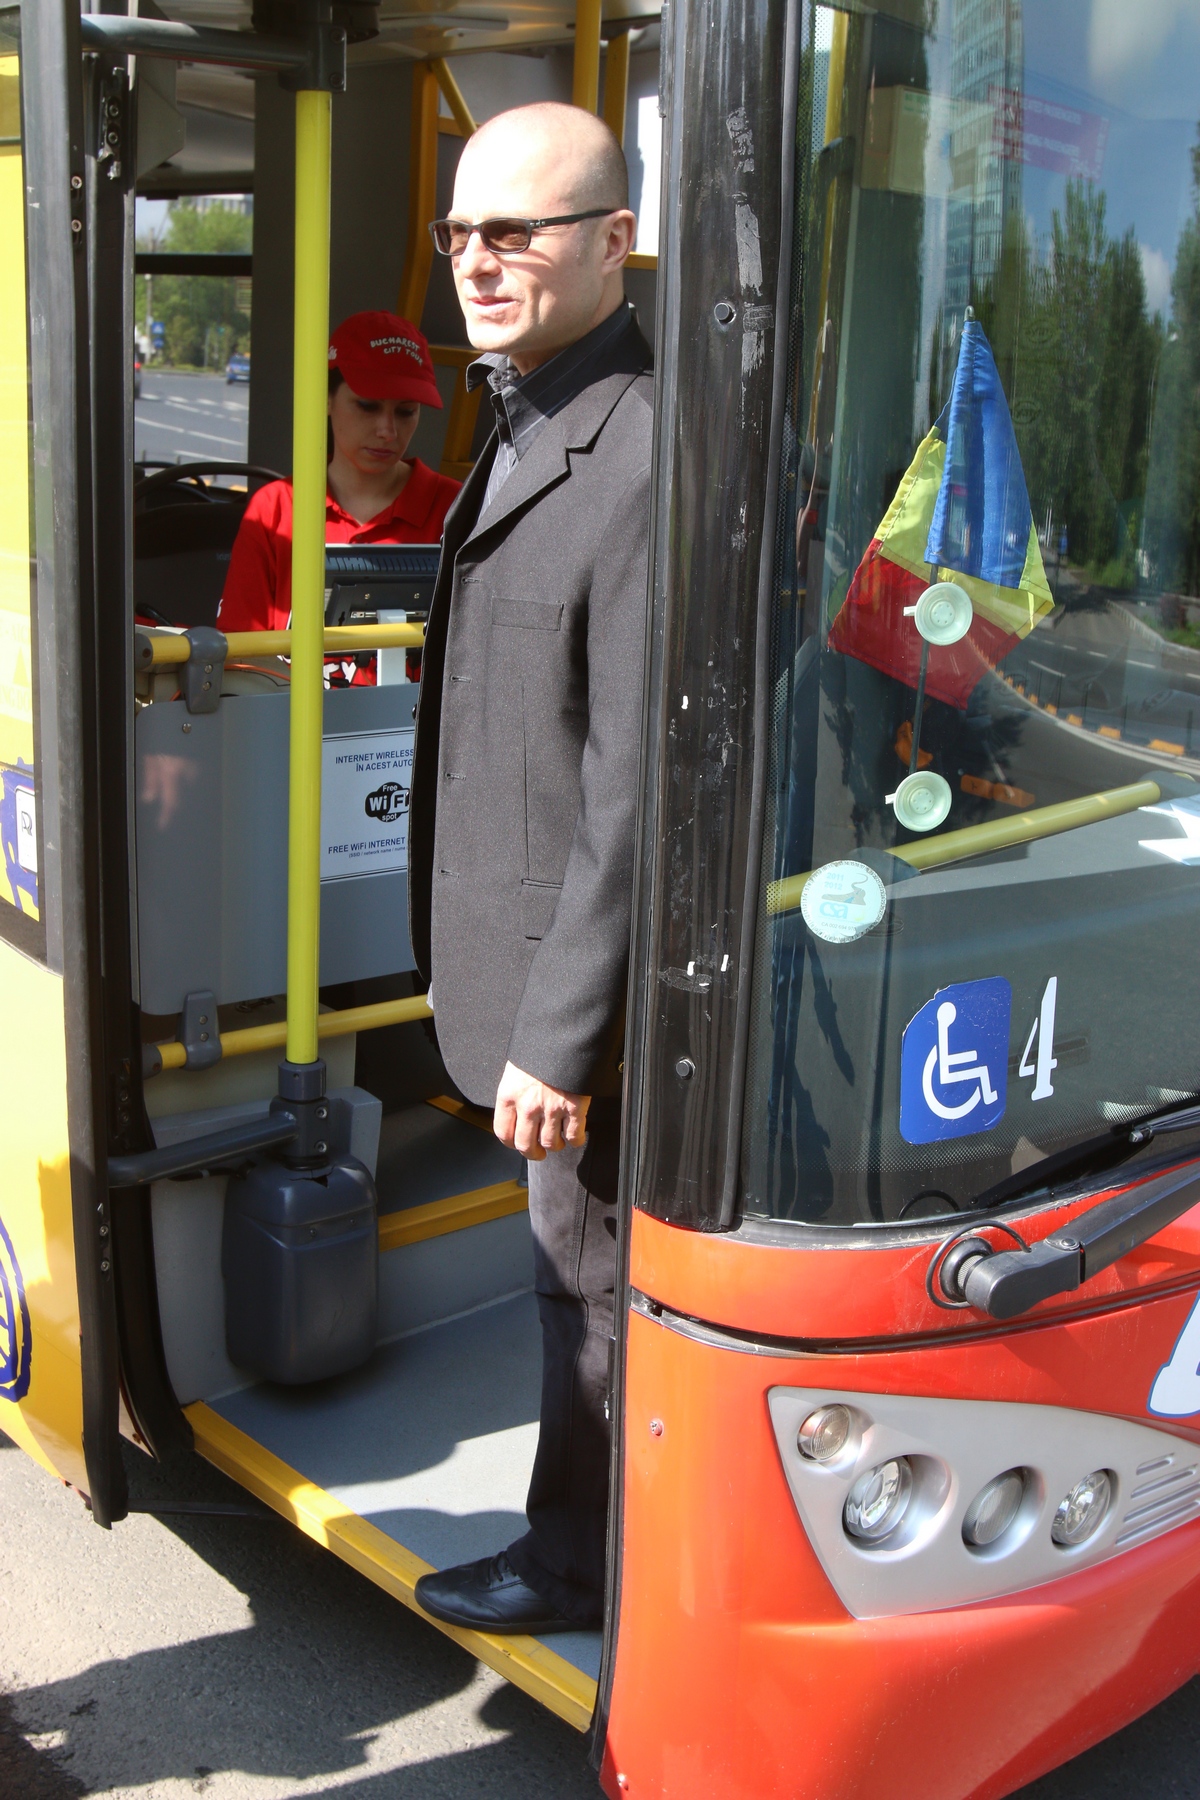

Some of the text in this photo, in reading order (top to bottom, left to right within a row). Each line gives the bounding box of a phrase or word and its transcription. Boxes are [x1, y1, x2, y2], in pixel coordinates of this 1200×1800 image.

[370, 337, 419, 351] BUCHAREST
[384, 346, 423, 366] CITY TOUR
[335, 749, 413, 764] INTERNET WIRELESS
[355, 763, 364, 772] ÎN
[365, 761, 391, 771] ACEST
[382, 784, 398, 792] Free
[381, 812, 397, 822] spot
[328, 836, 406, 854] FREE WiFi INTERNET
[826, 872, 844, 881] 2011
[824, 881, 843, 890] 2012
[1019, 976, 1057, 1101] 4
